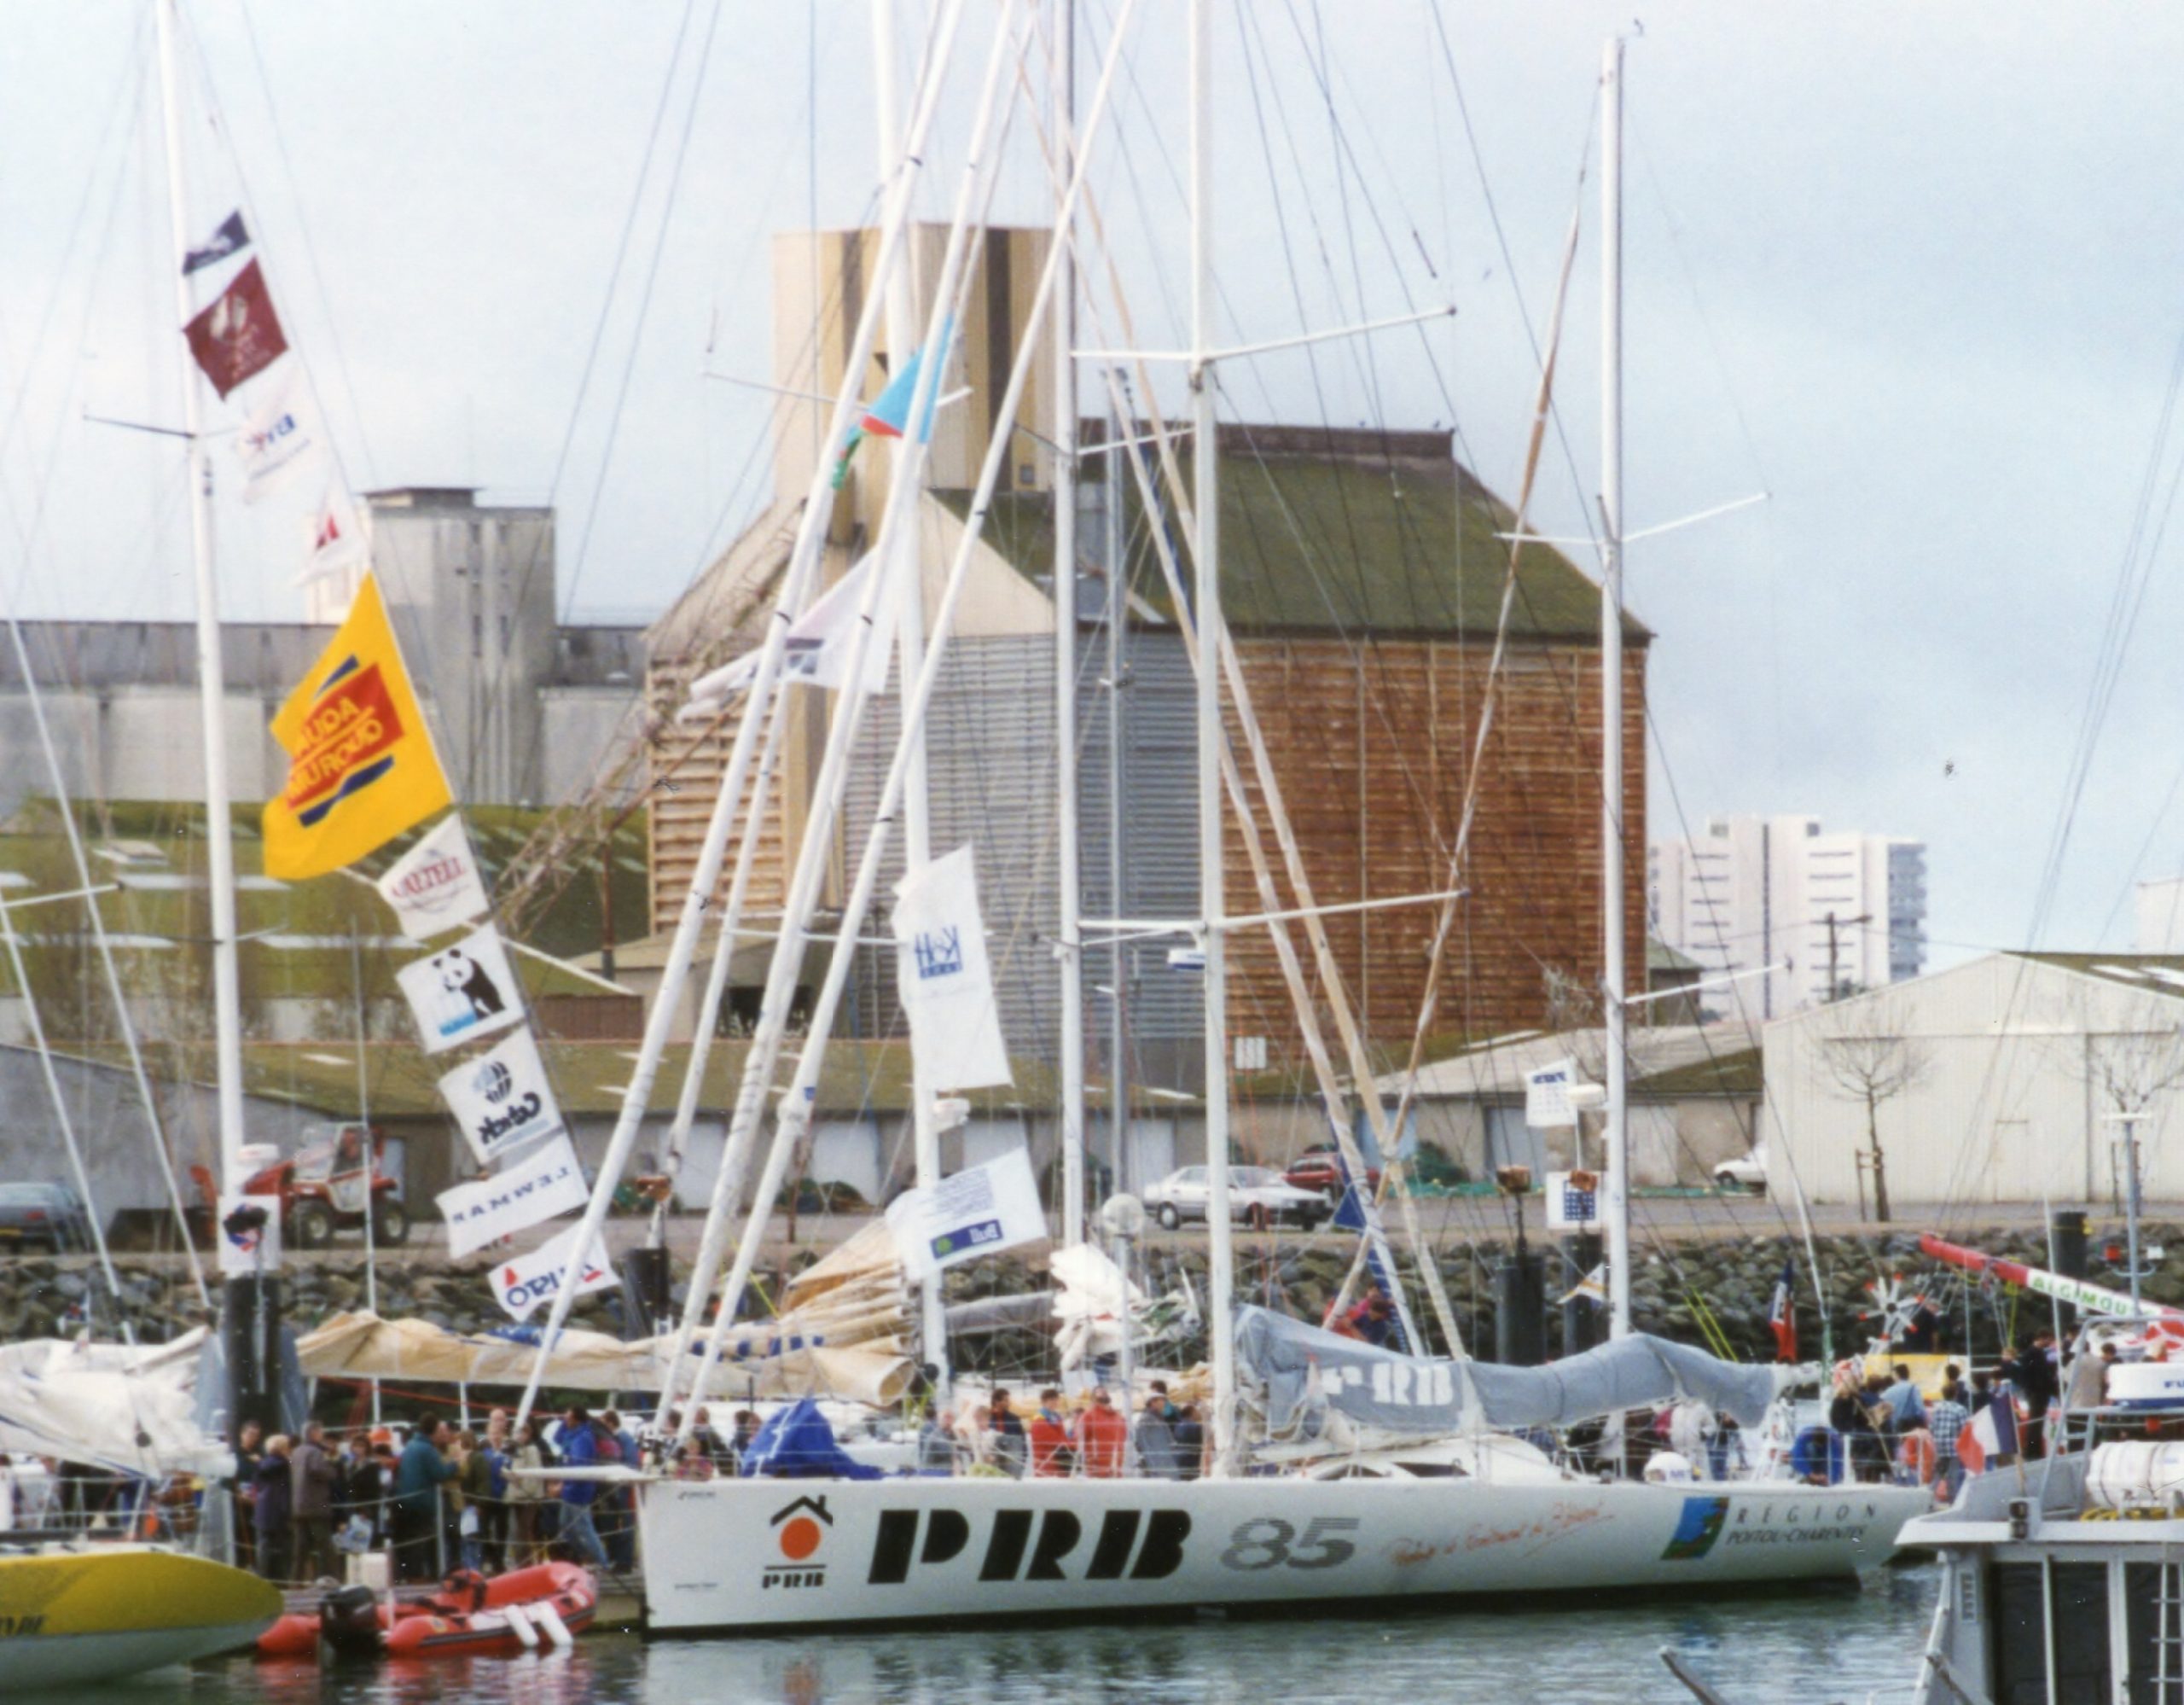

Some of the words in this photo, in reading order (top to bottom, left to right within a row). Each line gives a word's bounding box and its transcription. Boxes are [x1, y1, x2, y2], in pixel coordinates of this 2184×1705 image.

[867, 1509, 1192, 1585] PRB
[1219, 1516, 1360, 1571] 85
[762, 1572, 824, 1590] PRB
